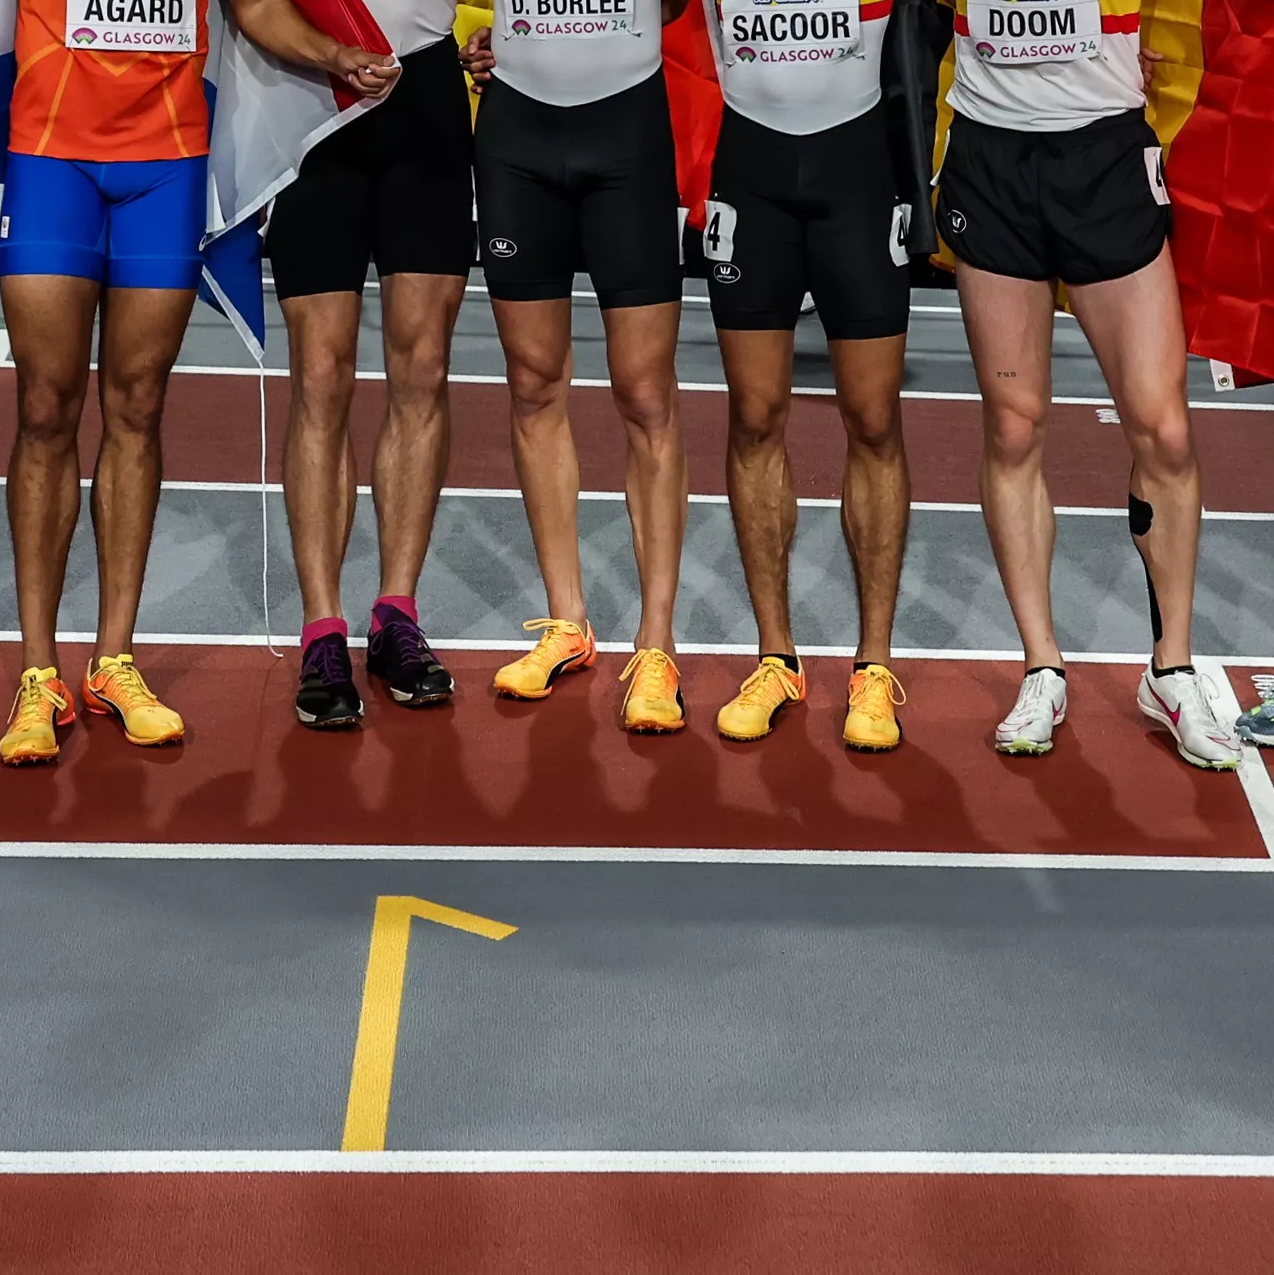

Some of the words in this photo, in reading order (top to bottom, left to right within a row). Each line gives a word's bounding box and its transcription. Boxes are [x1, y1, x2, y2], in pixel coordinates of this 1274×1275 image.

[535, 21, 608, 35] GLASGOW
[611, 19, 628, 31] 24
[732, 11, 851, 42] SACOOR
[989, 8, 1076, 37] DOOM
[103, 32, 175, 45] GLASGOW
[178, 34, 191, 45] 24
[760, 48, 835, 63] GLASGOW
[838, 47, 855, 59] 24
[1000, 43, 1076, 58] GLASGOW
[1080, 41, 1097, 53] 24
[707, 211, 721, 251] 4
